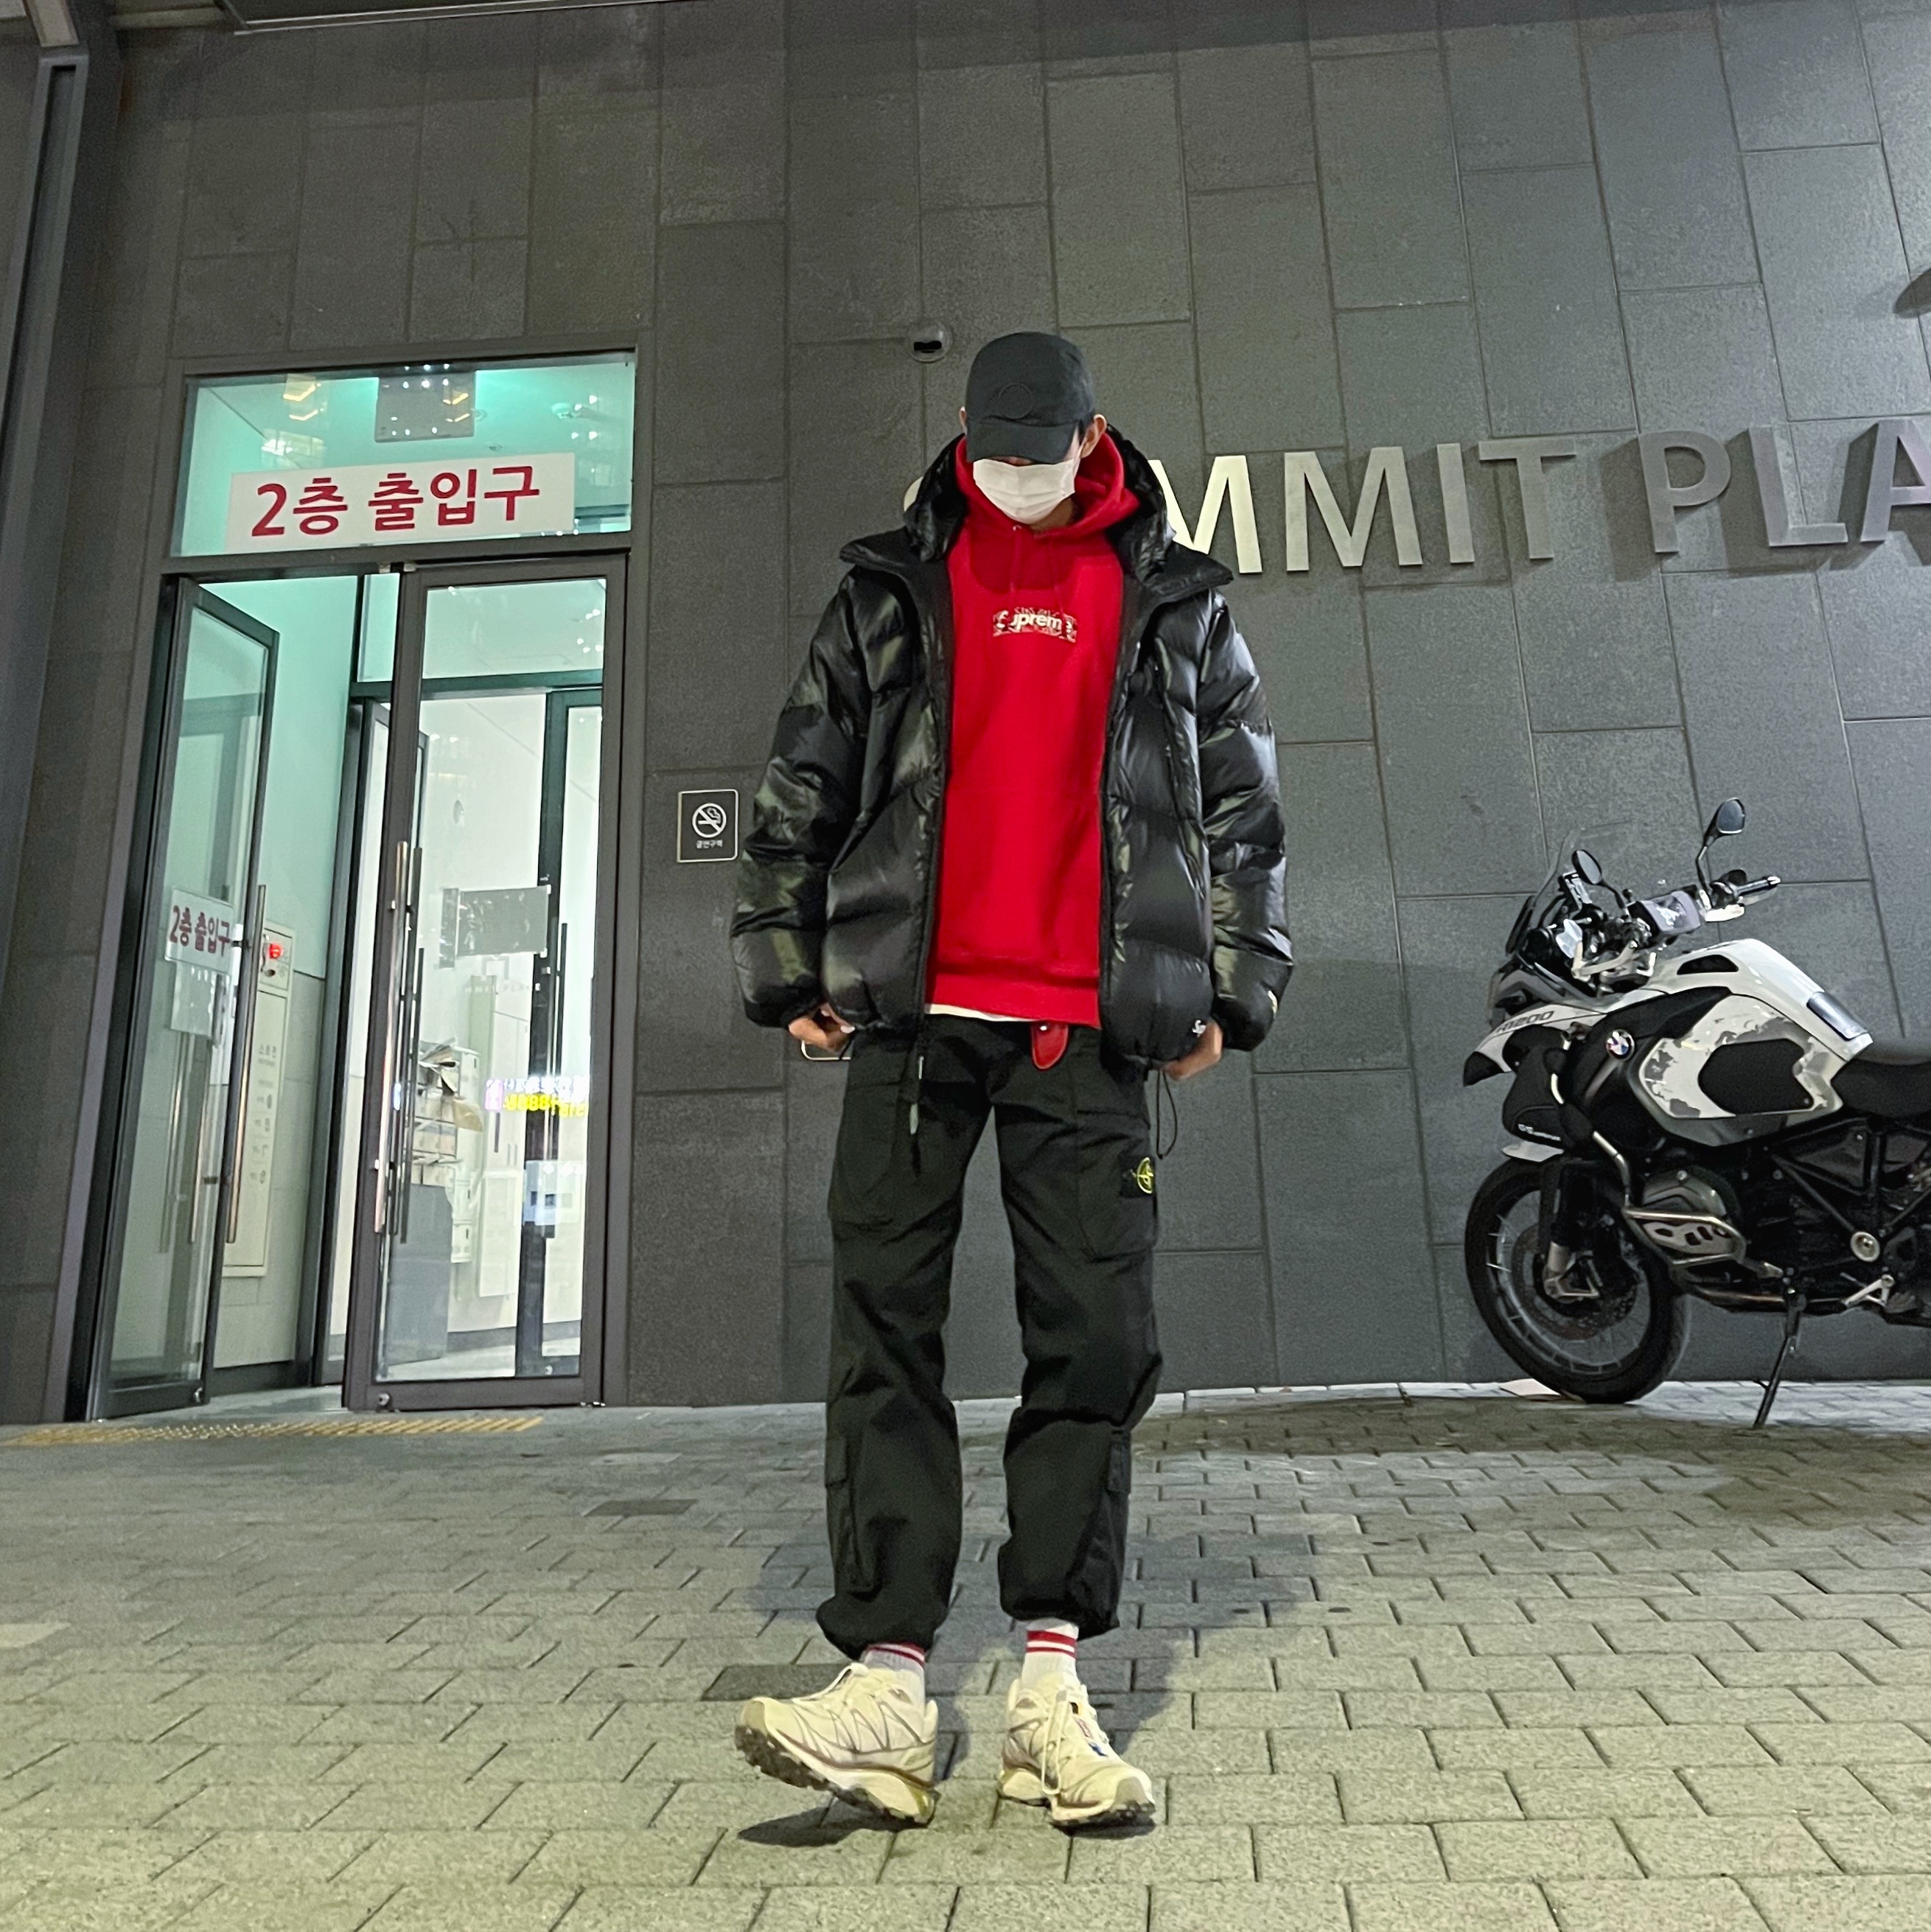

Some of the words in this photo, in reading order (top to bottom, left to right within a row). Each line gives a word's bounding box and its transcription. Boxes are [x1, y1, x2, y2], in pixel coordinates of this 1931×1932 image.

[251, 477, 348, 537] 2층
[368, 465, 540, 531] 출입구
[904, 442, 1576, 574] MMIT
[1638, 418, 1931, 554] PLA
[169, 904, 192, 947] 2층
[195, 911, 231, 958] 출입구
